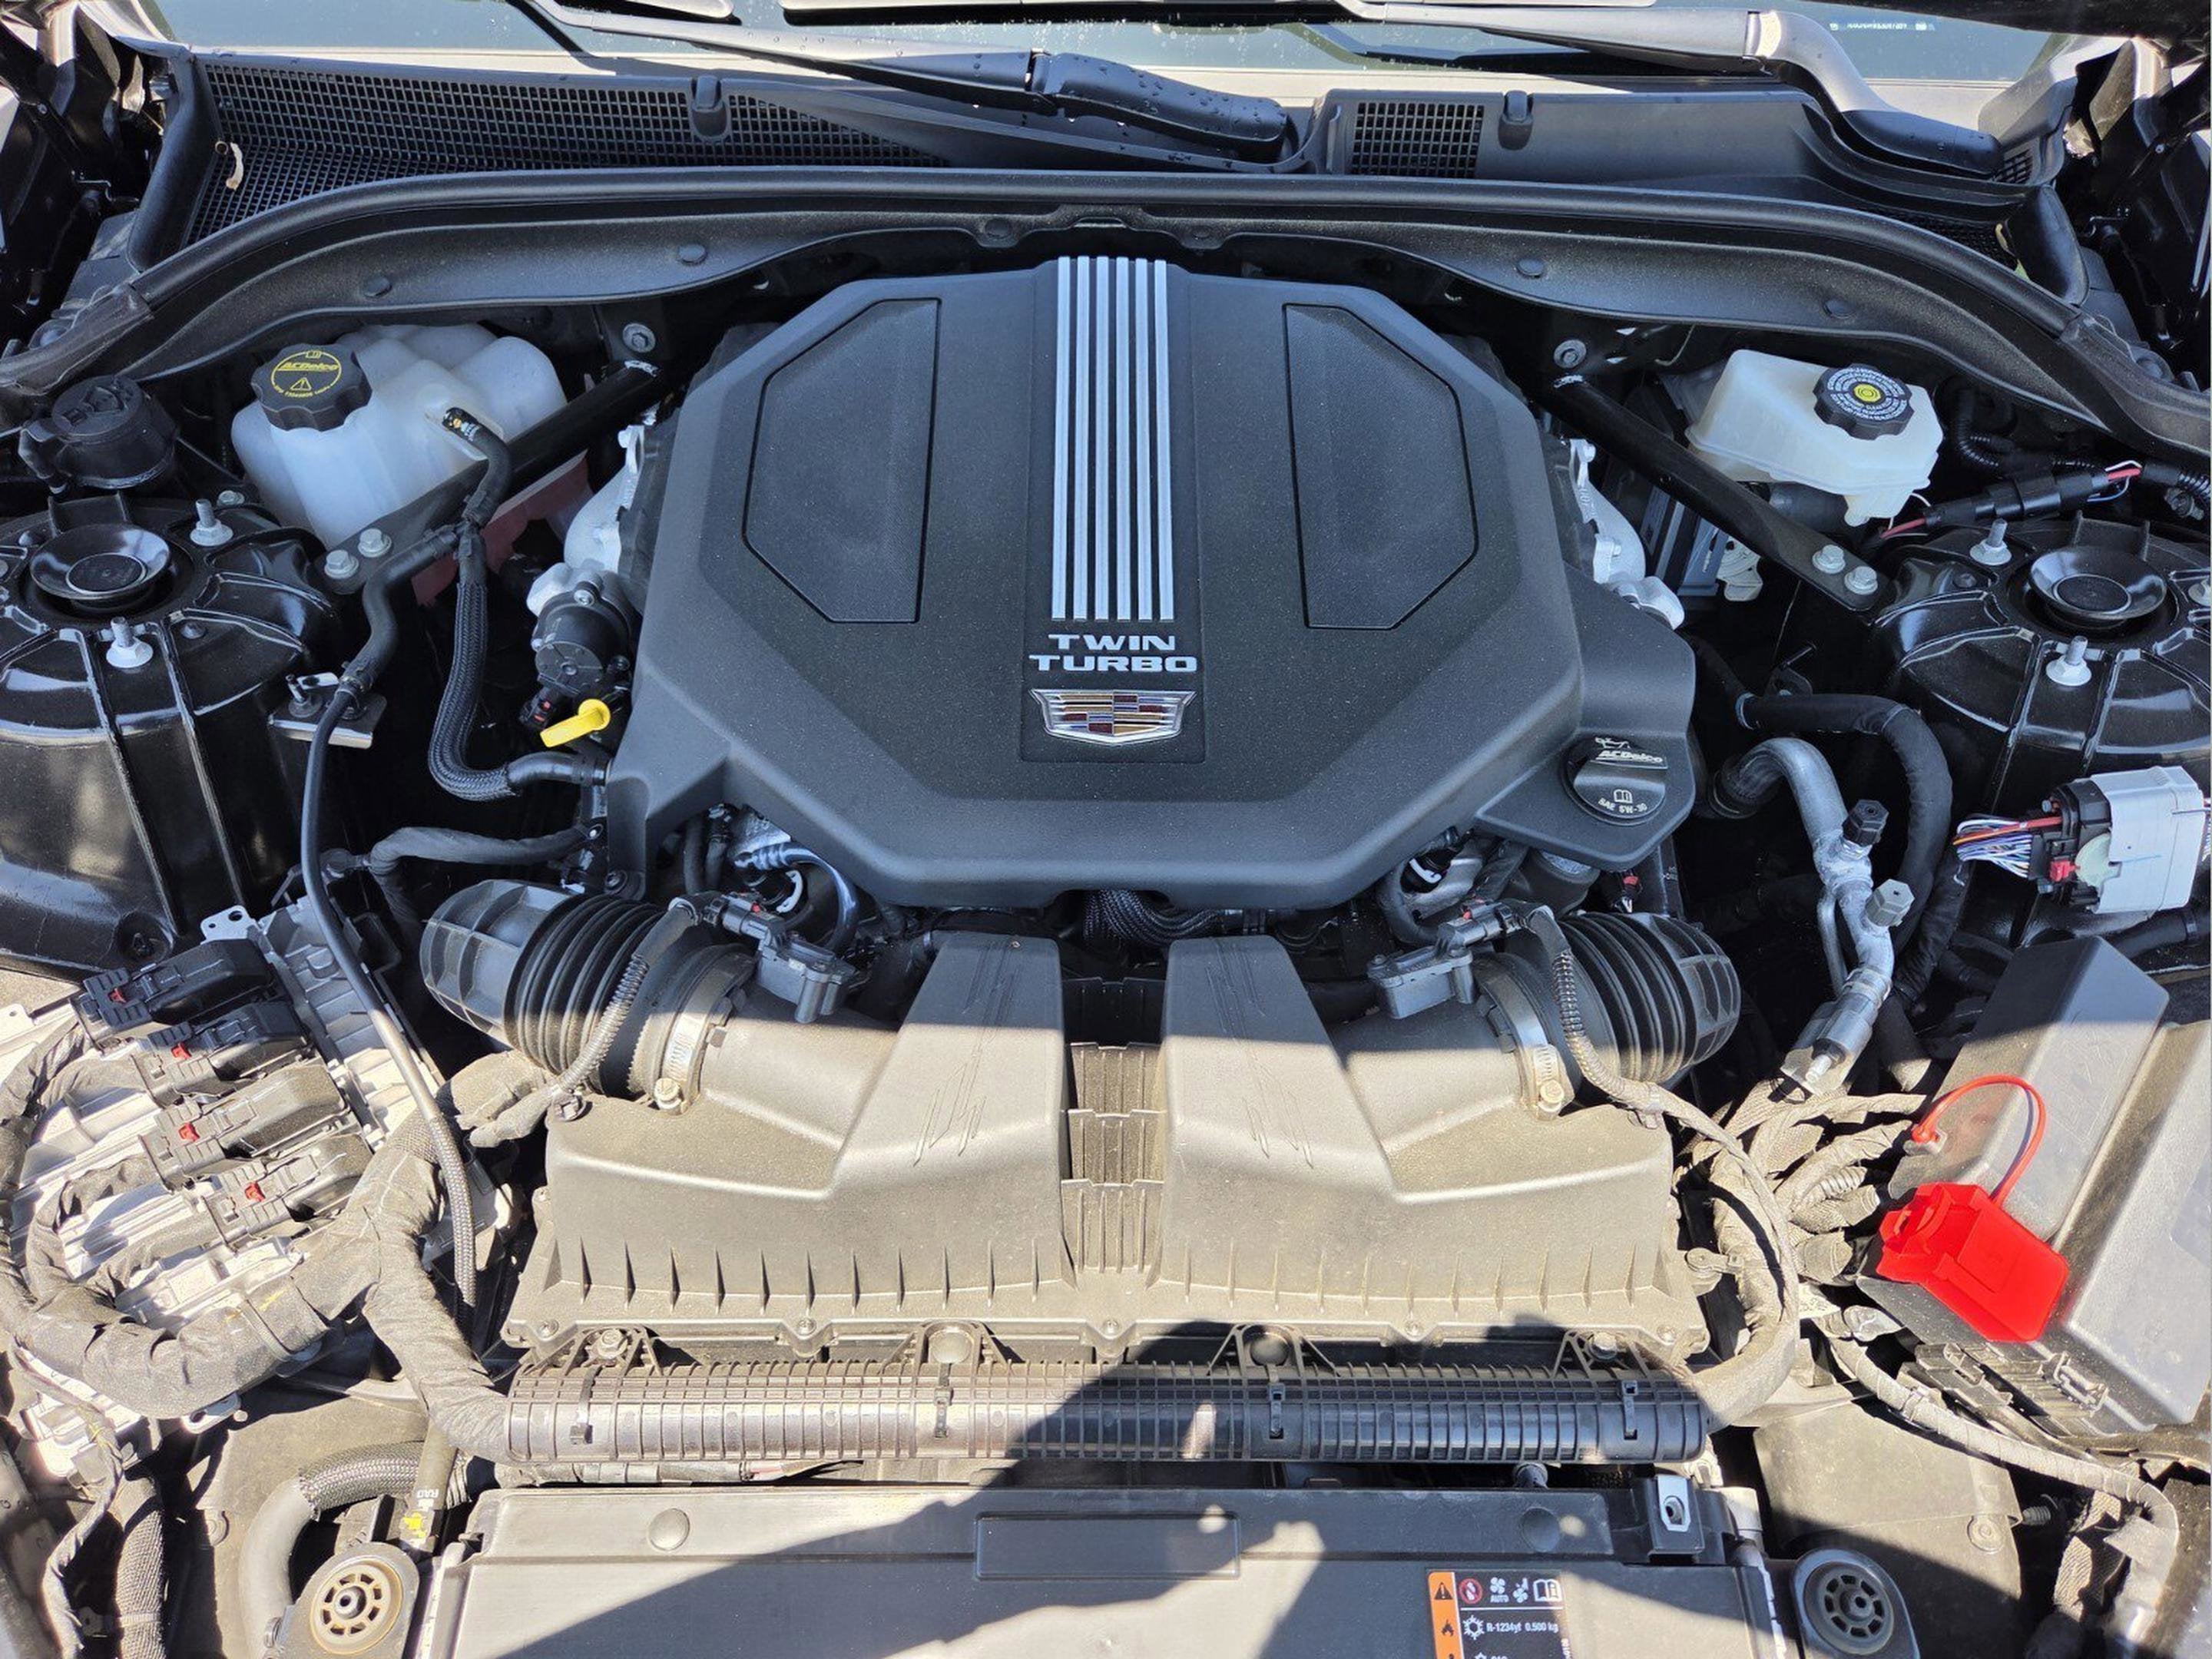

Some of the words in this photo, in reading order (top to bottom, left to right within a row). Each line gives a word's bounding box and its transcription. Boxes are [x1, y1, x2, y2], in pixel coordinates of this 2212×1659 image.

[278, 362, 339, 372] ACDelco
[1048, 634, 1176, 651] TWIN
[1028, 654, 1197, 672] TURBO
[1596, 750, 1663, 763] ACDelco
[1598, 797, 1615, 811] SAE
[1490, 1594, 1509, 1603] AUTO
[1486, 1622, 1521, 1633] R-1234yf
[1548, 1622, 1558, 1633] kg
